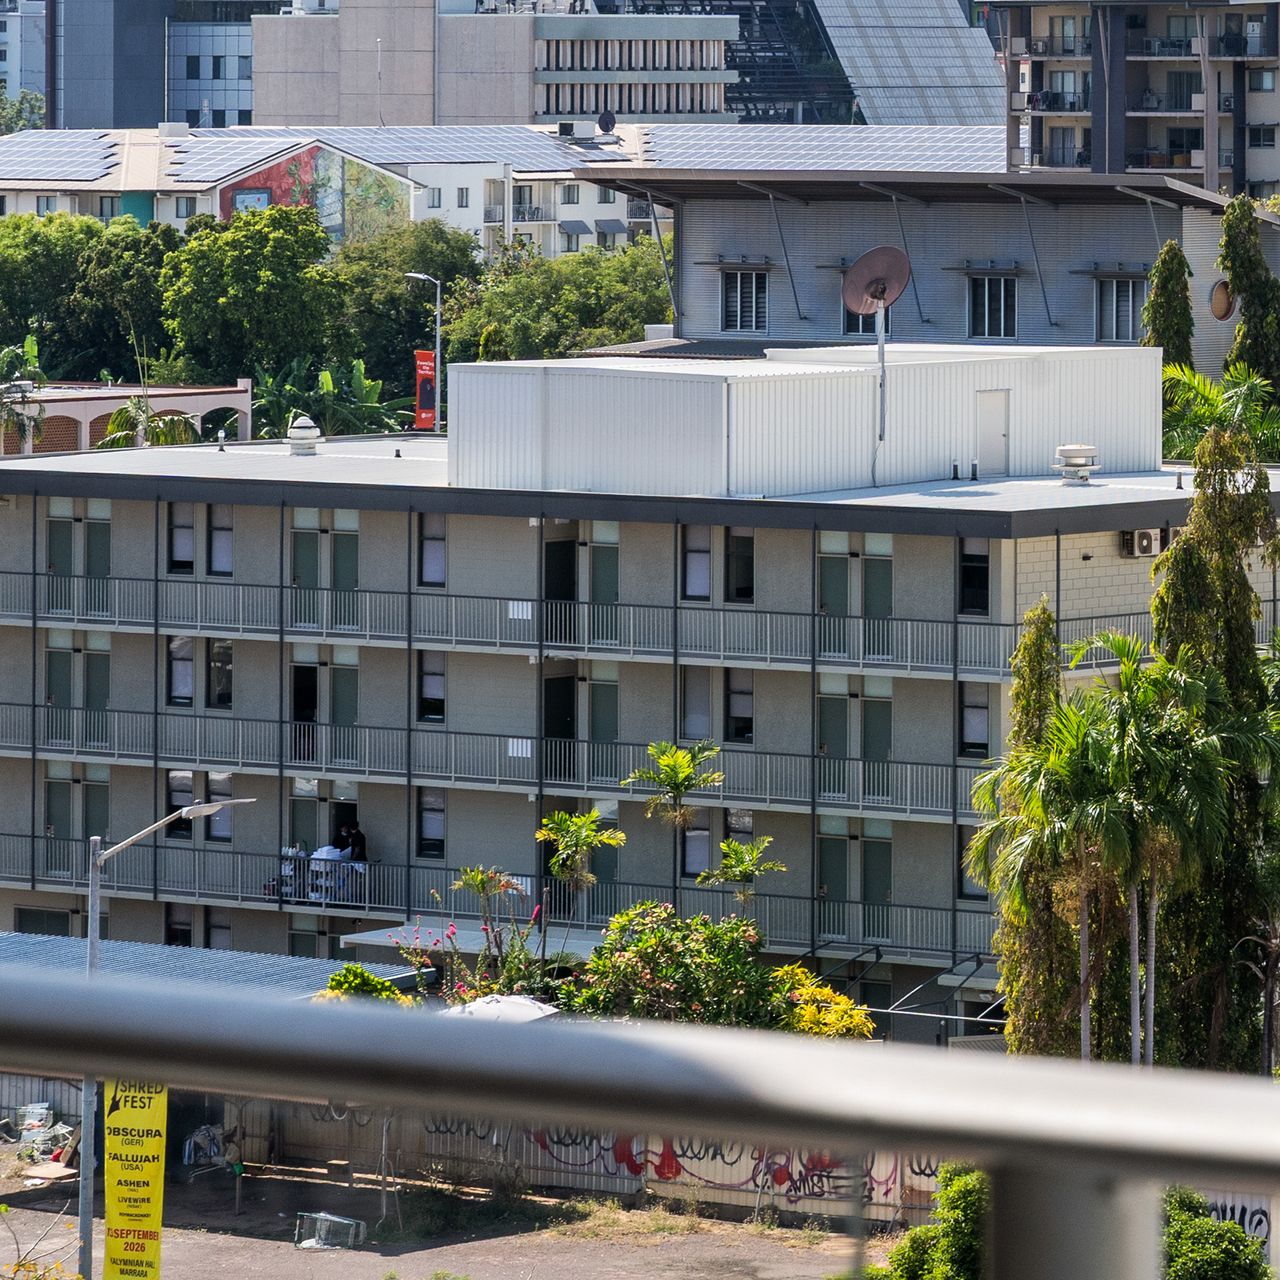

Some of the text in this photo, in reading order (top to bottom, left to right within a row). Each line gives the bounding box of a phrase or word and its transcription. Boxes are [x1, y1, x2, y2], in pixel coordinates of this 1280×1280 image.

[120, 1080, 164, 1095] SHRED
[123, 1095, 154, 1110] FEST
[121, 1137, 144, 1148] (GER)
[120, 1163, 144, 1172] (USA)
[116, 1179, 150, 1188] ASHEN
[123, 1241, 146, 1253] 2026
